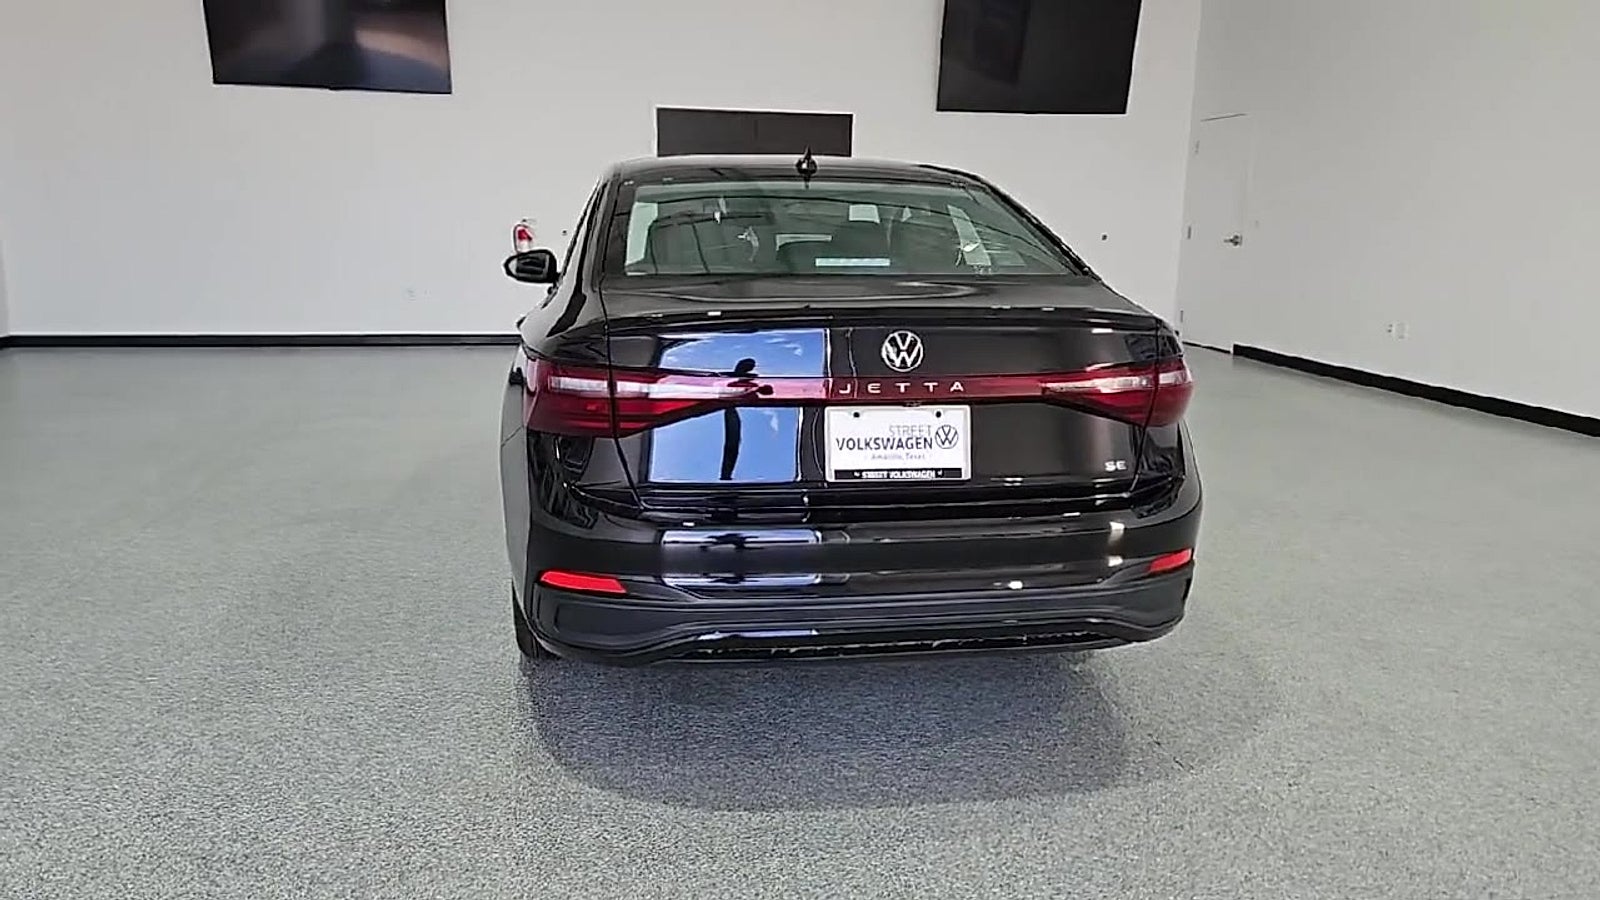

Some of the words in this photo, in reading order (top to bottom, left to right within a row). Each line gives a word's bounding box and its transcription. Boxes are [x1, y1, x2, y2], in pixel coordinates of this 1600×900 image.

[838, 382, 964, 394] JETTA
[888, 424, 932, 437] STREET
[835, 436, 933, 451] VOLKSWAGEN
[1104, 460, 1127, 472] SE
